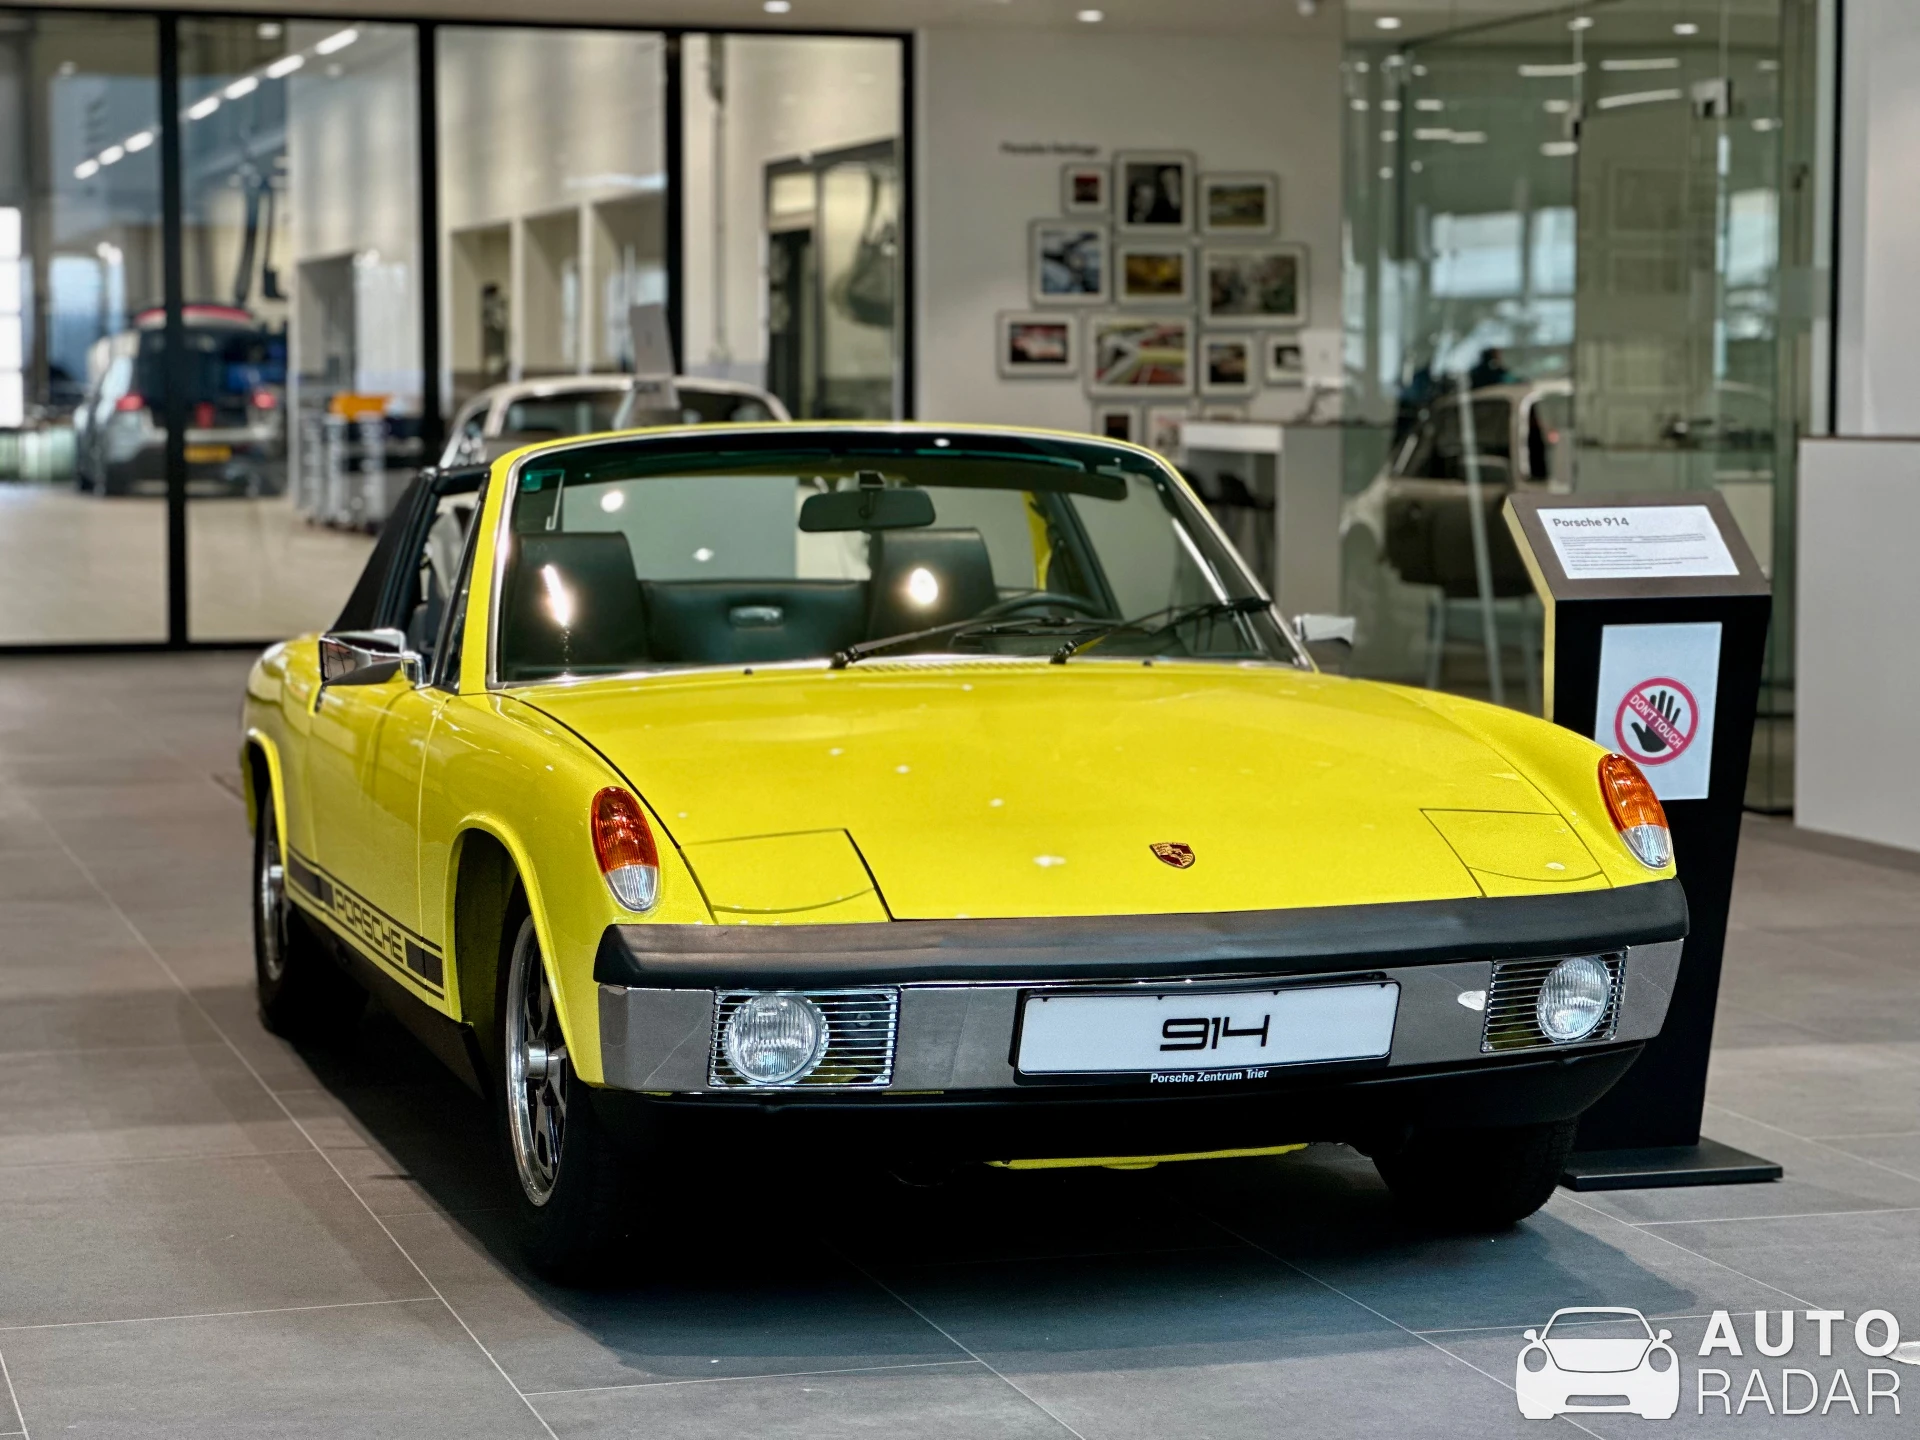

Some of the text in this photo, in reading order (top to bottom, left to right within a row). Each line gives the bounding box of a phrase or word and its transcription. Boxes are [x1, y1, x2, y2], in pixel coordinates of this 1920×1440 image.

[1552, 517, 1630, 527] Porsche 914
[1629, 694, 1685, 749] DON'T TOUCH
[335, 888, 404, 964] PORSCHE
[1159, 1014, 1271, 1051] 914
[1150, 1069, 1269, 1083] Porsche Zentrum Trier
